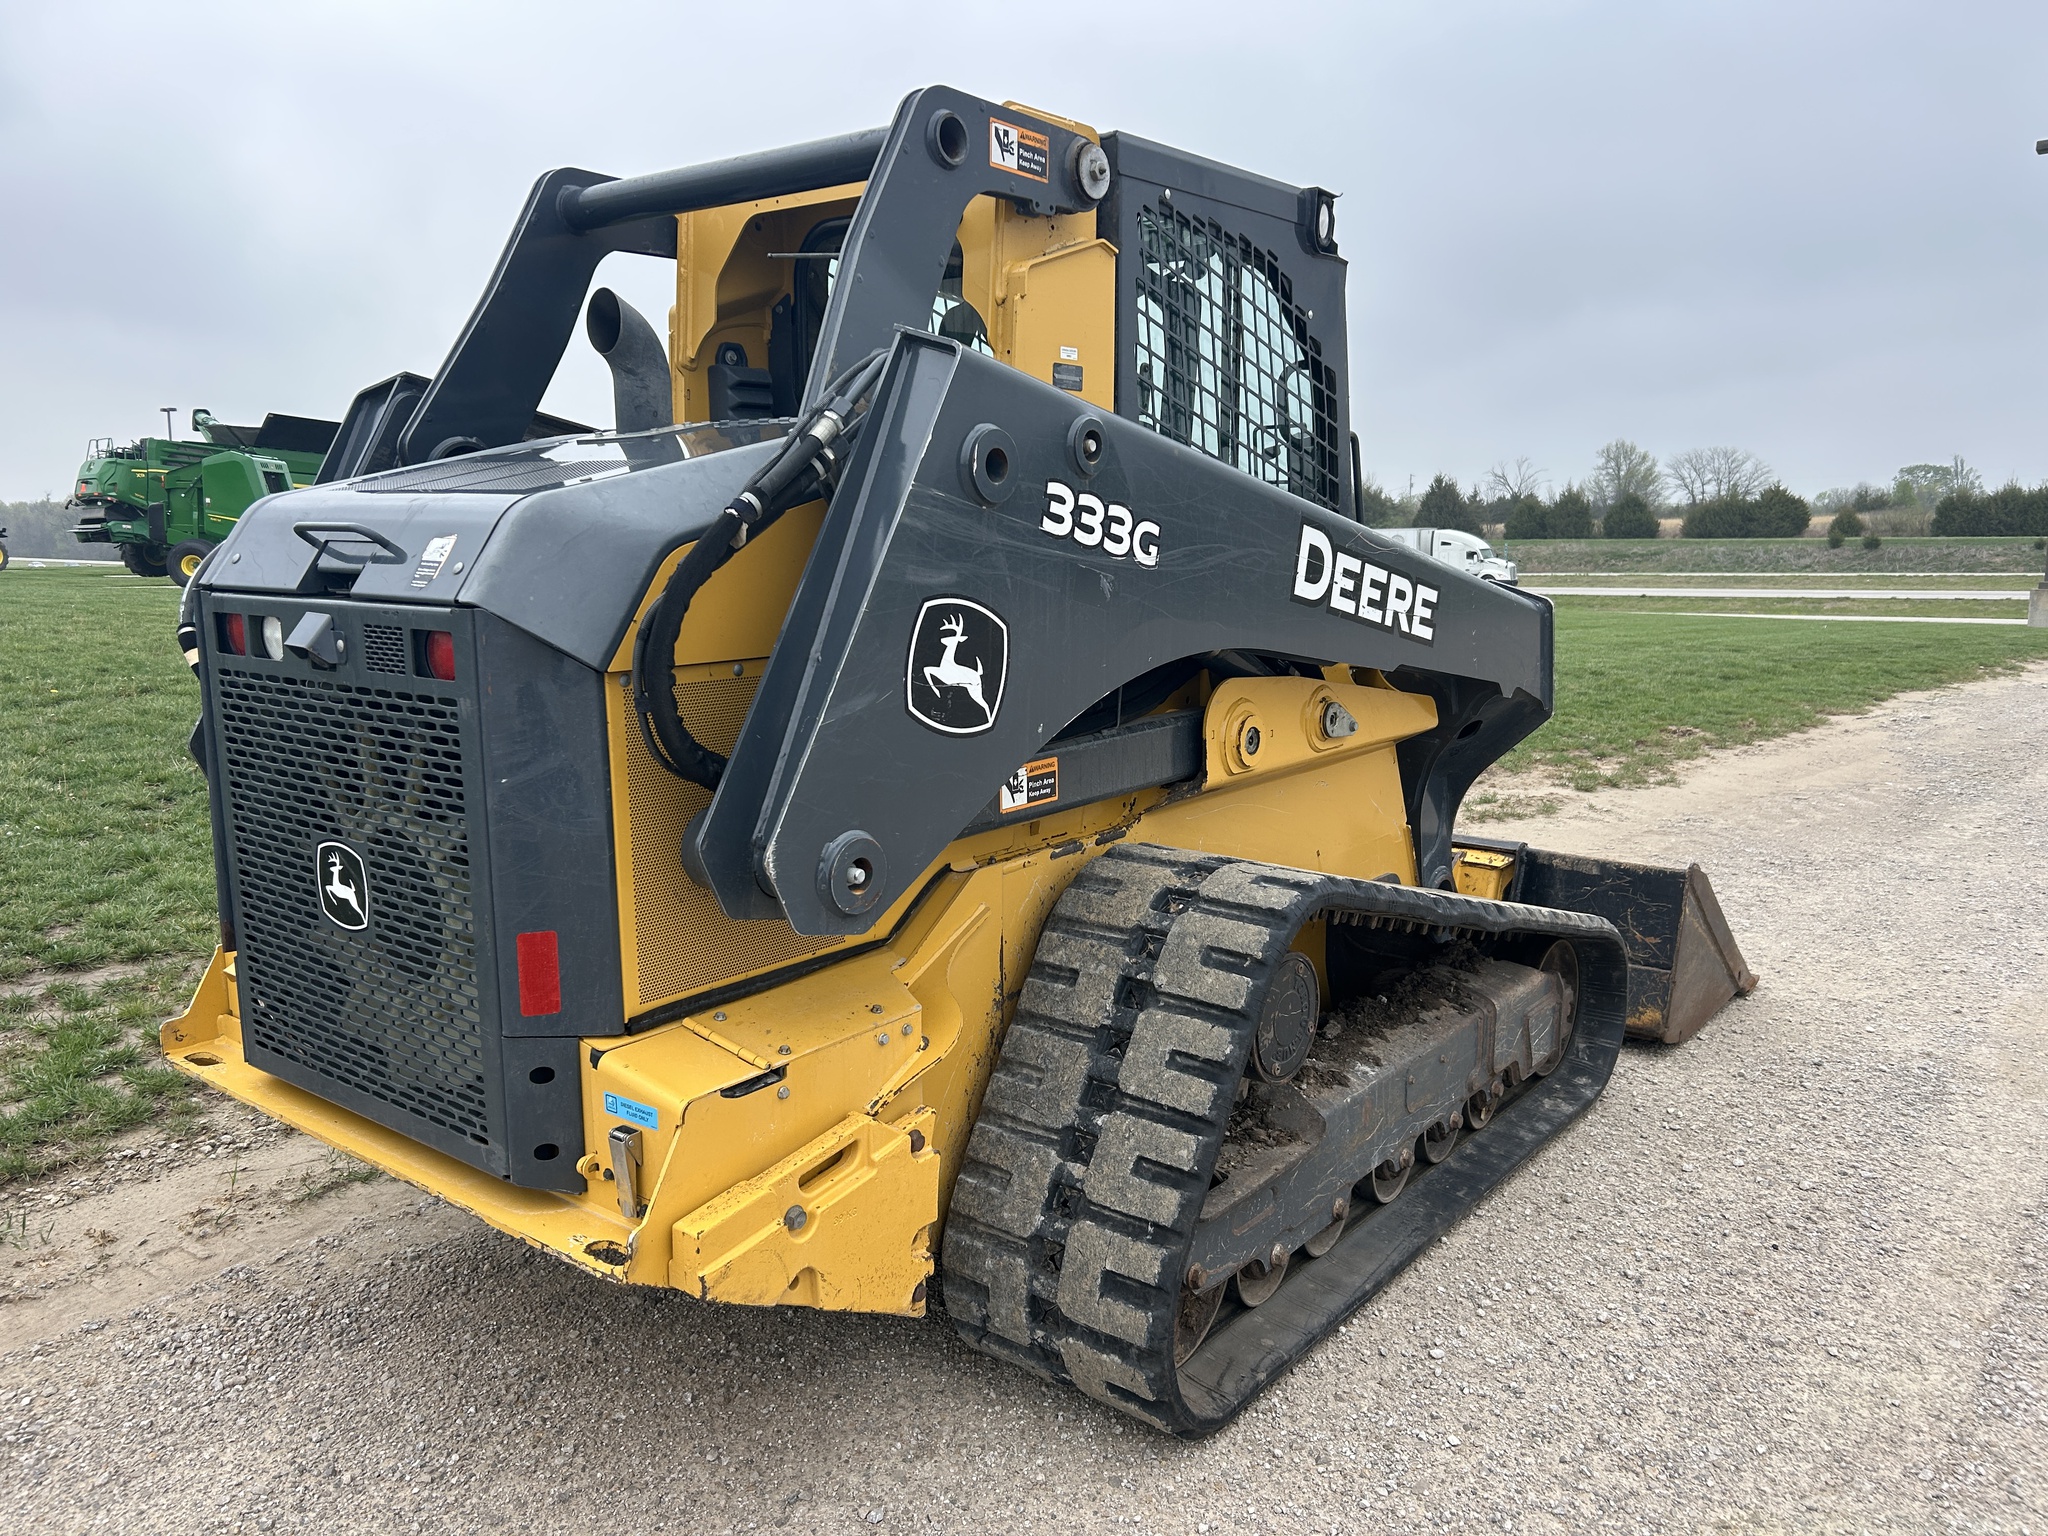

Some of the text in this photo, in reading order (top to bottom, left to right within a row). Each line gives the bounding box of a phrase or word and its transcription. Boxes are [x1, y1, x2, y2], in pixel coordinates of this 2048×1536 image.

[1024, 132, 1047, 146] WARNING
[1019, 148, 1046, 164] Pinch Area
[1019, 159, 1042, 172] Keep Away
[1042, 481, 1160, 566] 333G
[1293, 524, 1439, 641] DEERE
[1033, 762, 1055, 771] WARNING
[1029, 778, 1055, 788] Pinch Area
[621, 1101, 653, 1117] DIESEL EXHAUST
[639, 1114, 649, 1122] ONLY
